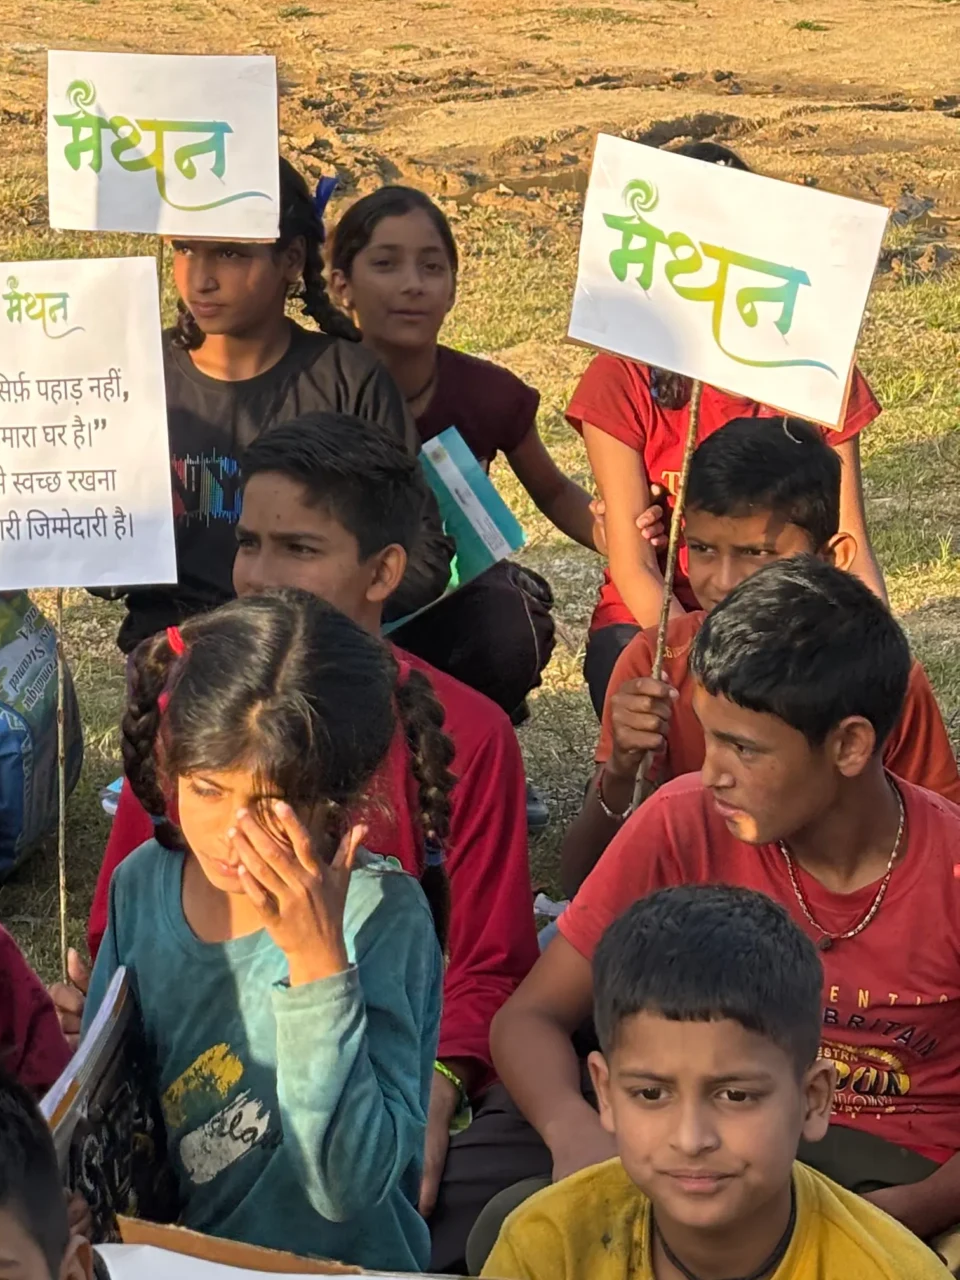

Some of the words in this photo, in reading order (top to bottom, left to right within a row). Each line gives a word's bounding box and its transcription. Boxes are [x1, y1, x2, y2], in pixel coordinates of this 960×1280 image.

[53, 79, 273, 211] मंथन
[602, 178, 839, 380] मंथन
[2, 275, 86, 339] मंथन
[35, 377, 84, 407] पहाड़
[87, 367, 130, 404] नहीं,
[41, 424, 68, 448] घर
[11, 470, 63, 495] स्वच्छ
[66, 468, 118, 493] रखना
[25, 506, 109, 541] जिम्मेदारी
[112, 505, 134, 541] है।
